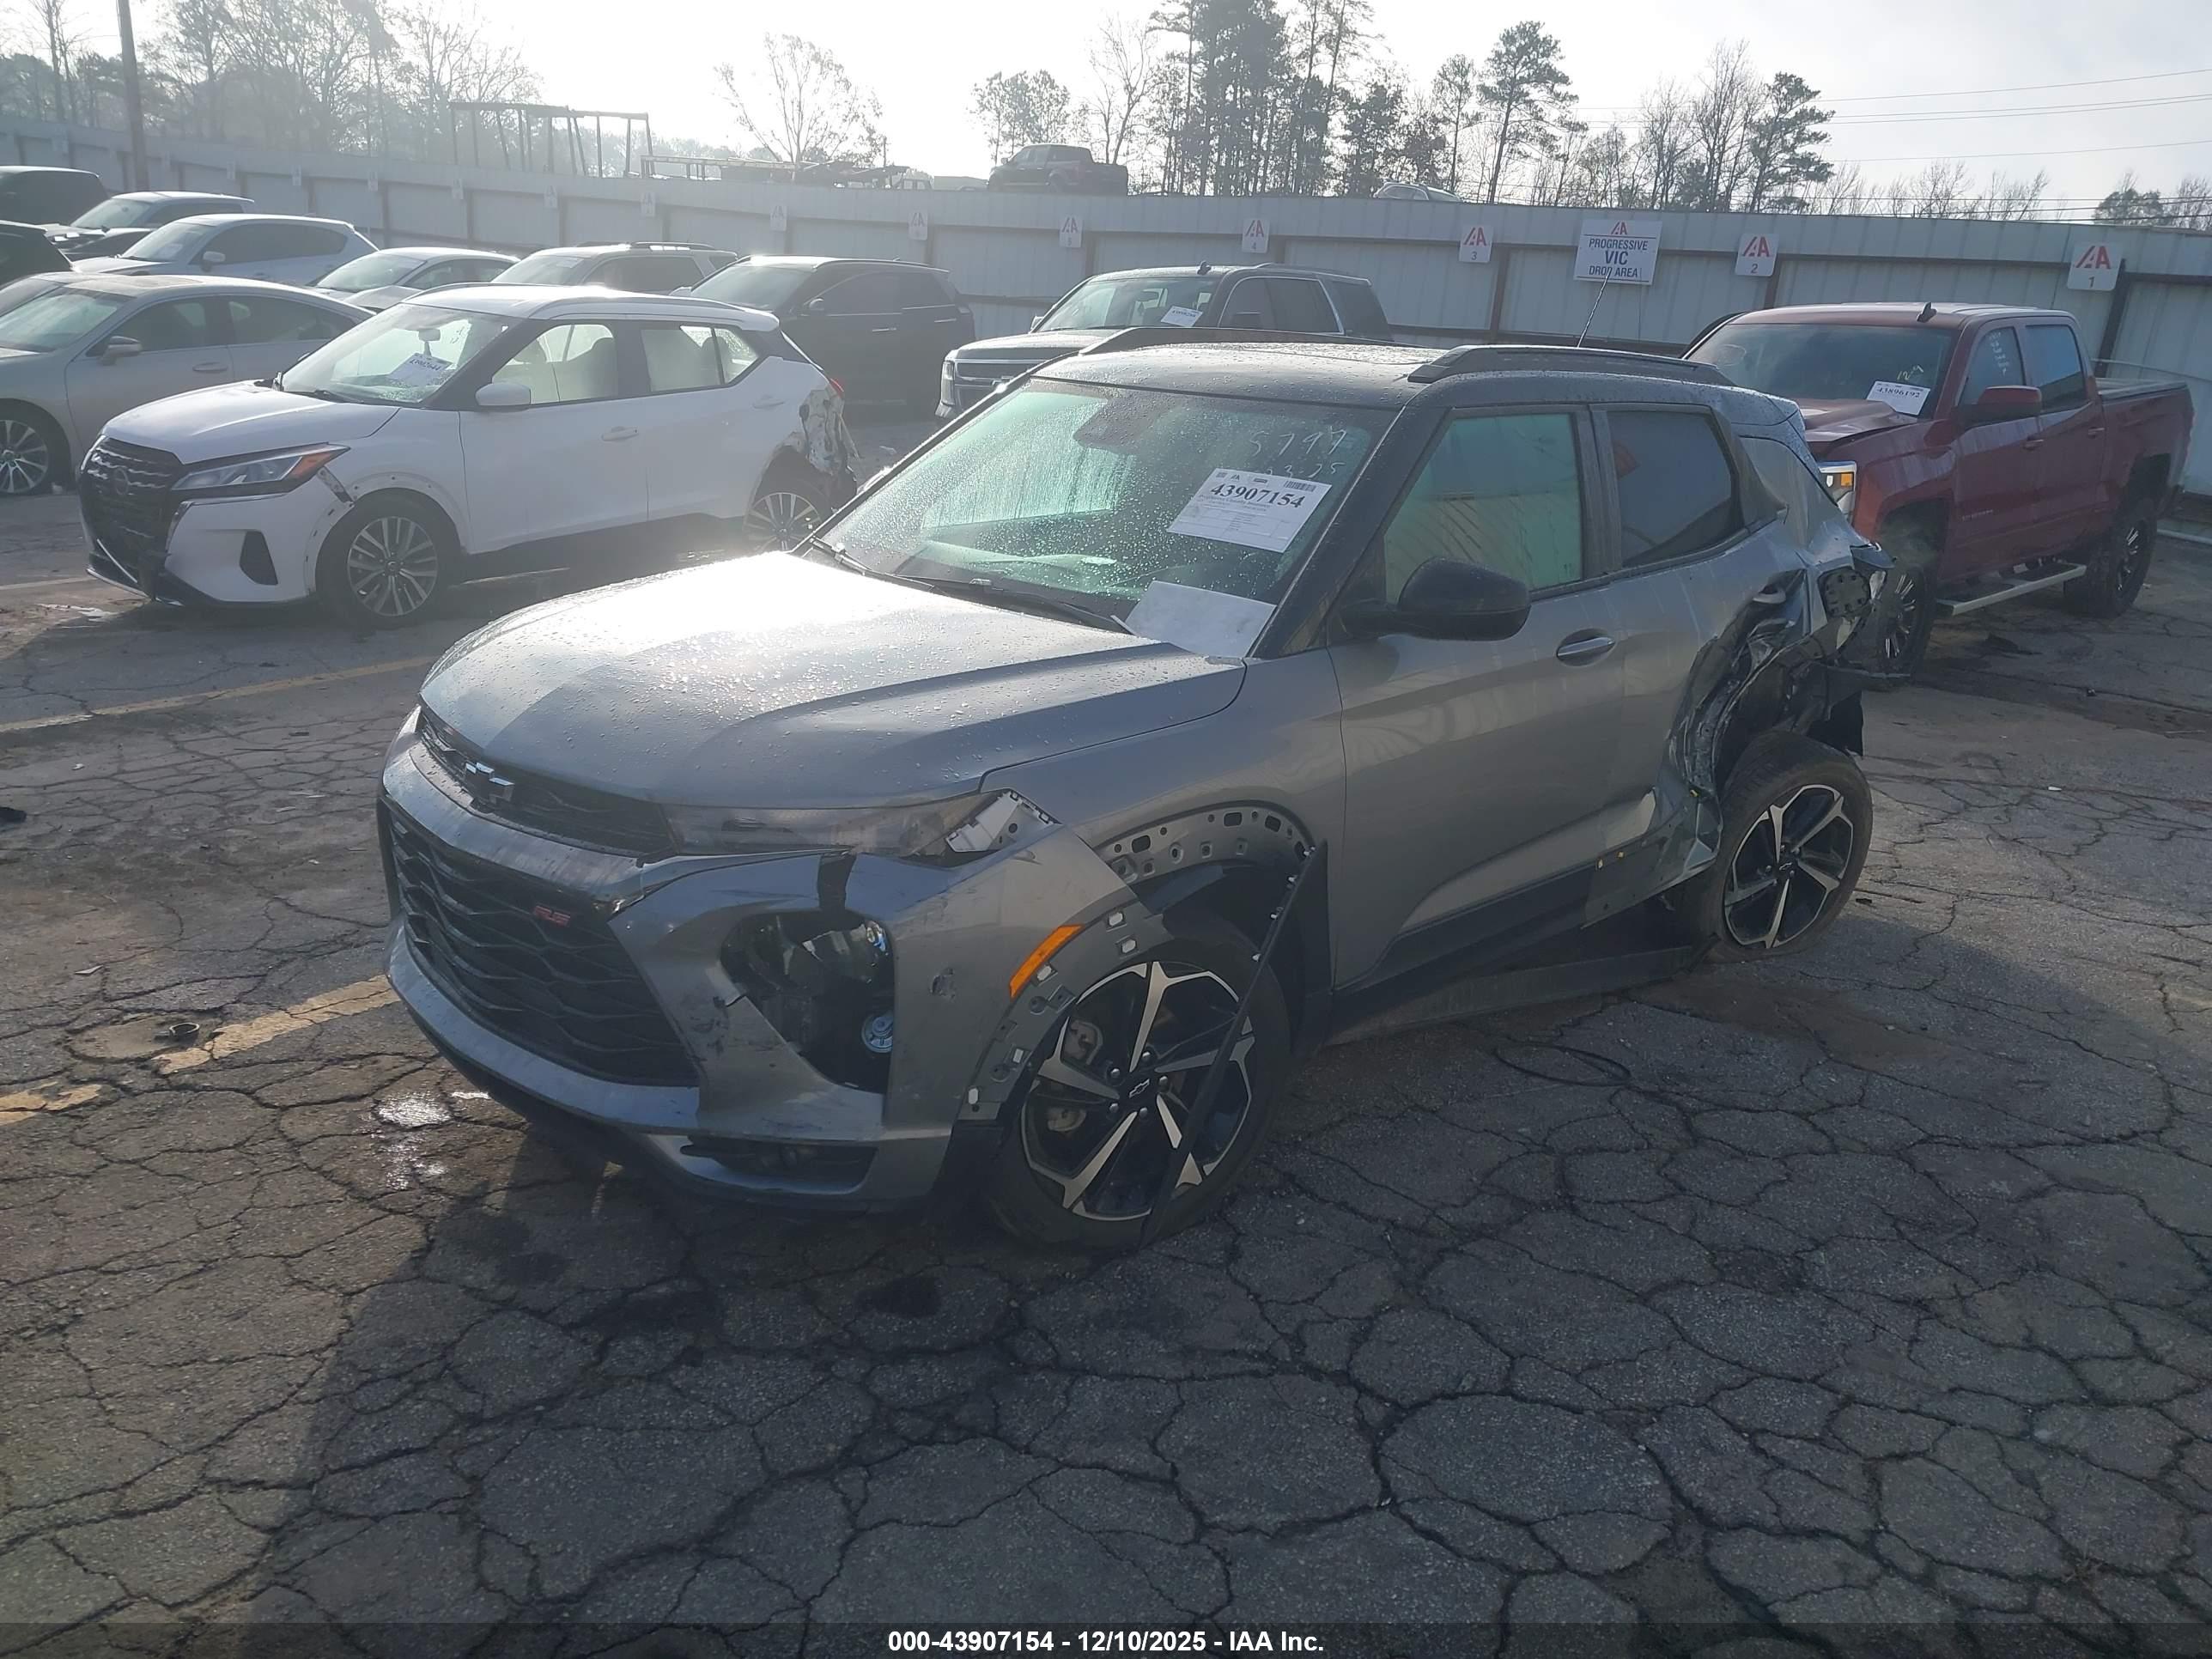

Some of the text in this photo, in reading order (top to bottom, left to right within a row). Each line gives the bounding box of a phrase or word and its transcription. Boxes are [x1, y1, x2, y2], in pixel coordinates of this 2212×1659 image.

[1589, 238, 1649, 251] PROGRESSIVE
[1471, 251, 1478, 261] 3
[1605, 251, 1629, 265] VIC
[1614, 266, 1638, 278] AREA
[1751, 263, 1759, 274] 2
[2087, 276, 2095, 289] 1
[1210, 483, 1306, 508] 43907154
